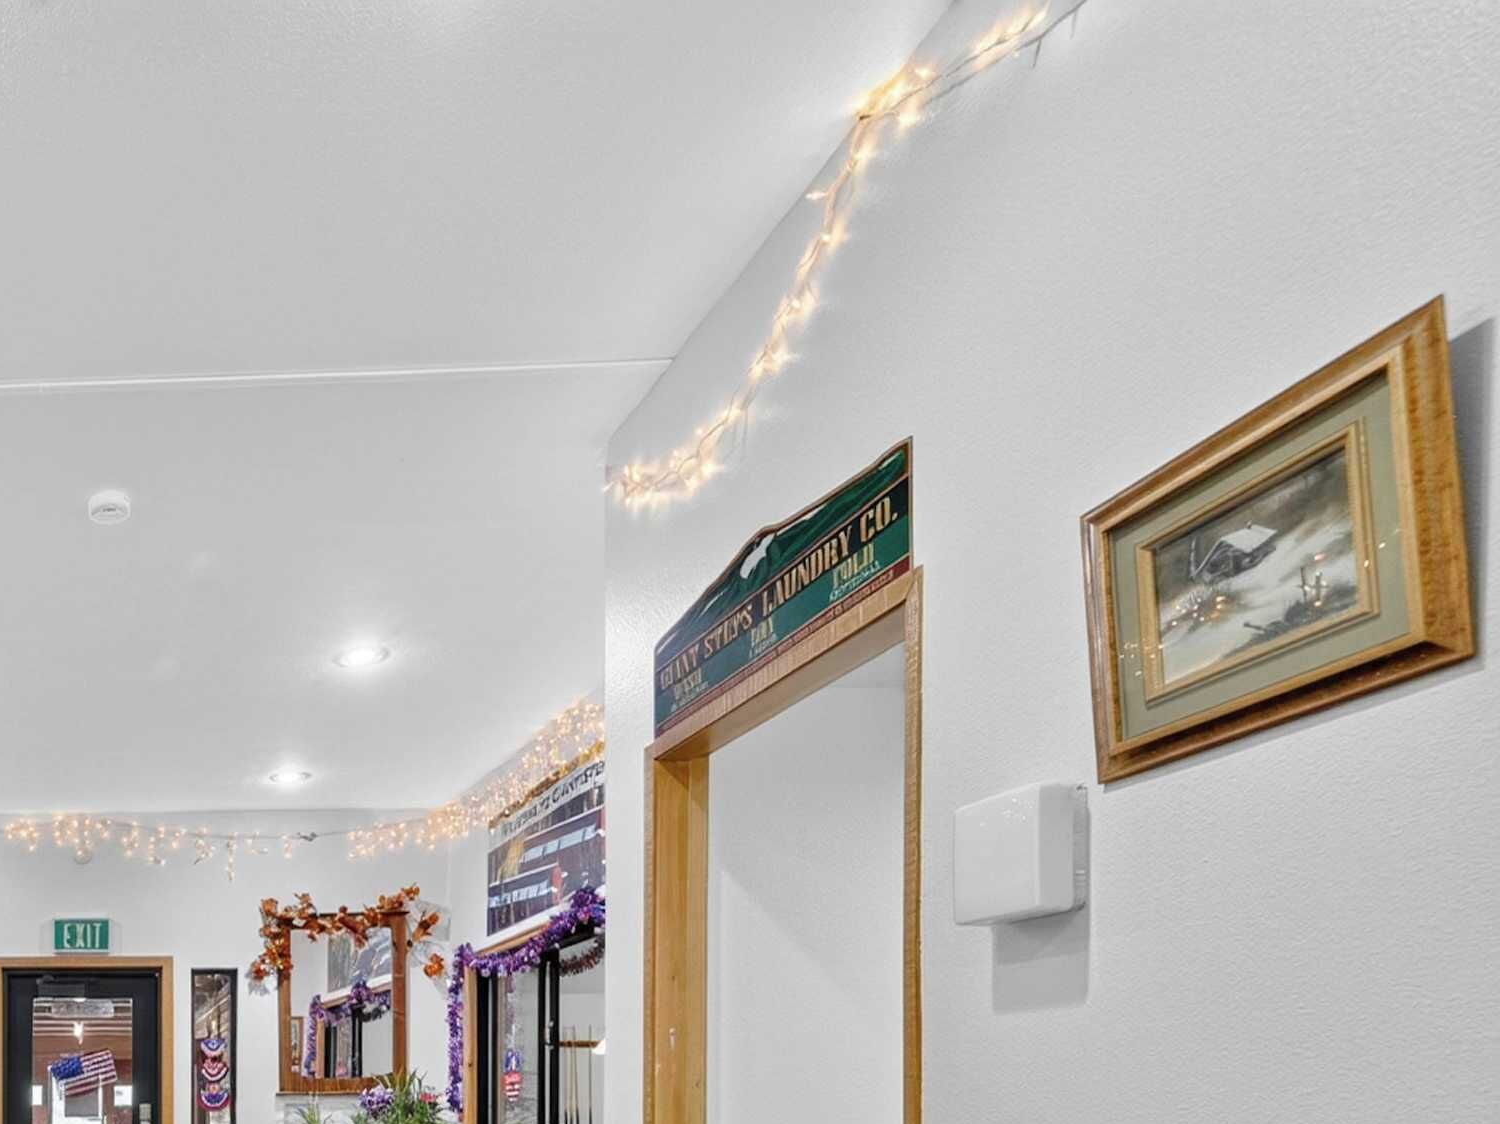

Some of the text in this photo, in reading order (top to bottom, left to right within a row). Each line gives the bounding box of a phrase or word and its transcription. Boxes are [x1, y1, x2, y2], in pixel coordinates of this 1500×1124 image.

[762, 525, 853, 617] LAUNDRY
[860, 496, 899, 543] CO.
[64, 923, 102, 949] EXIT
